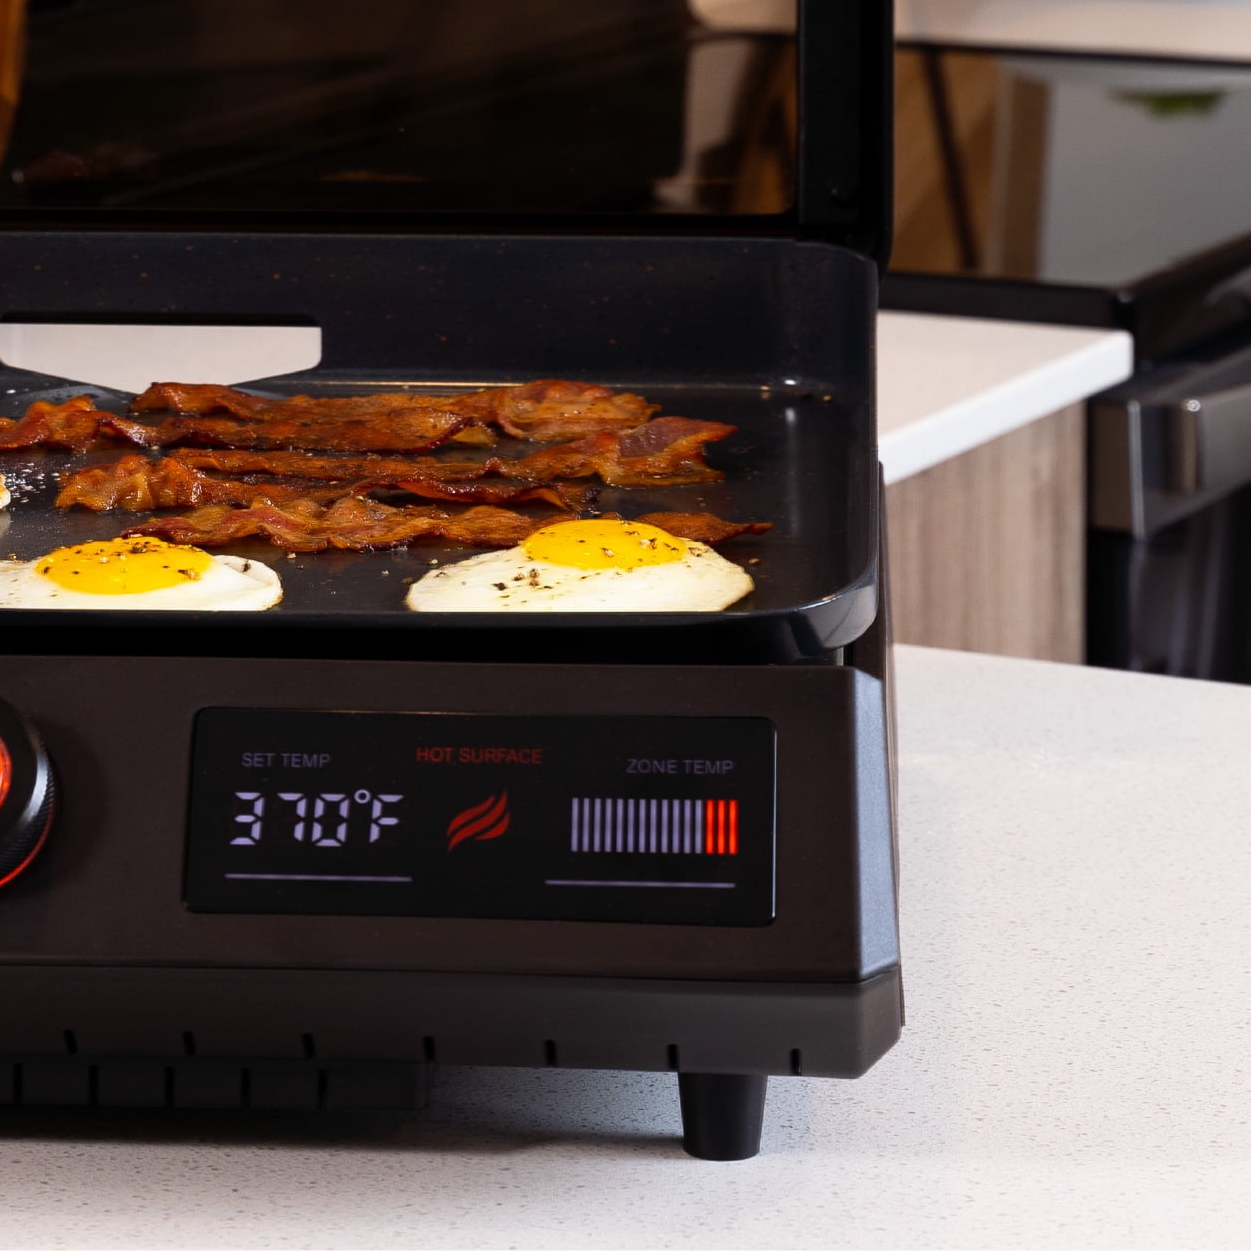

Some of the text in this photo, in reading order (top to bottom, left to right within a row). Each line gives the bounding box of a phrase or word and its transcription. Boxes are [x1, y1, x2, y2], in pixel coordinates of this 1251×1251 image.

[242, 753, 330, 768] SET TEMP
[417, 747, 542, 764] HOT SURFACE
[627, 759, 733, 774] ZONE TEMP
